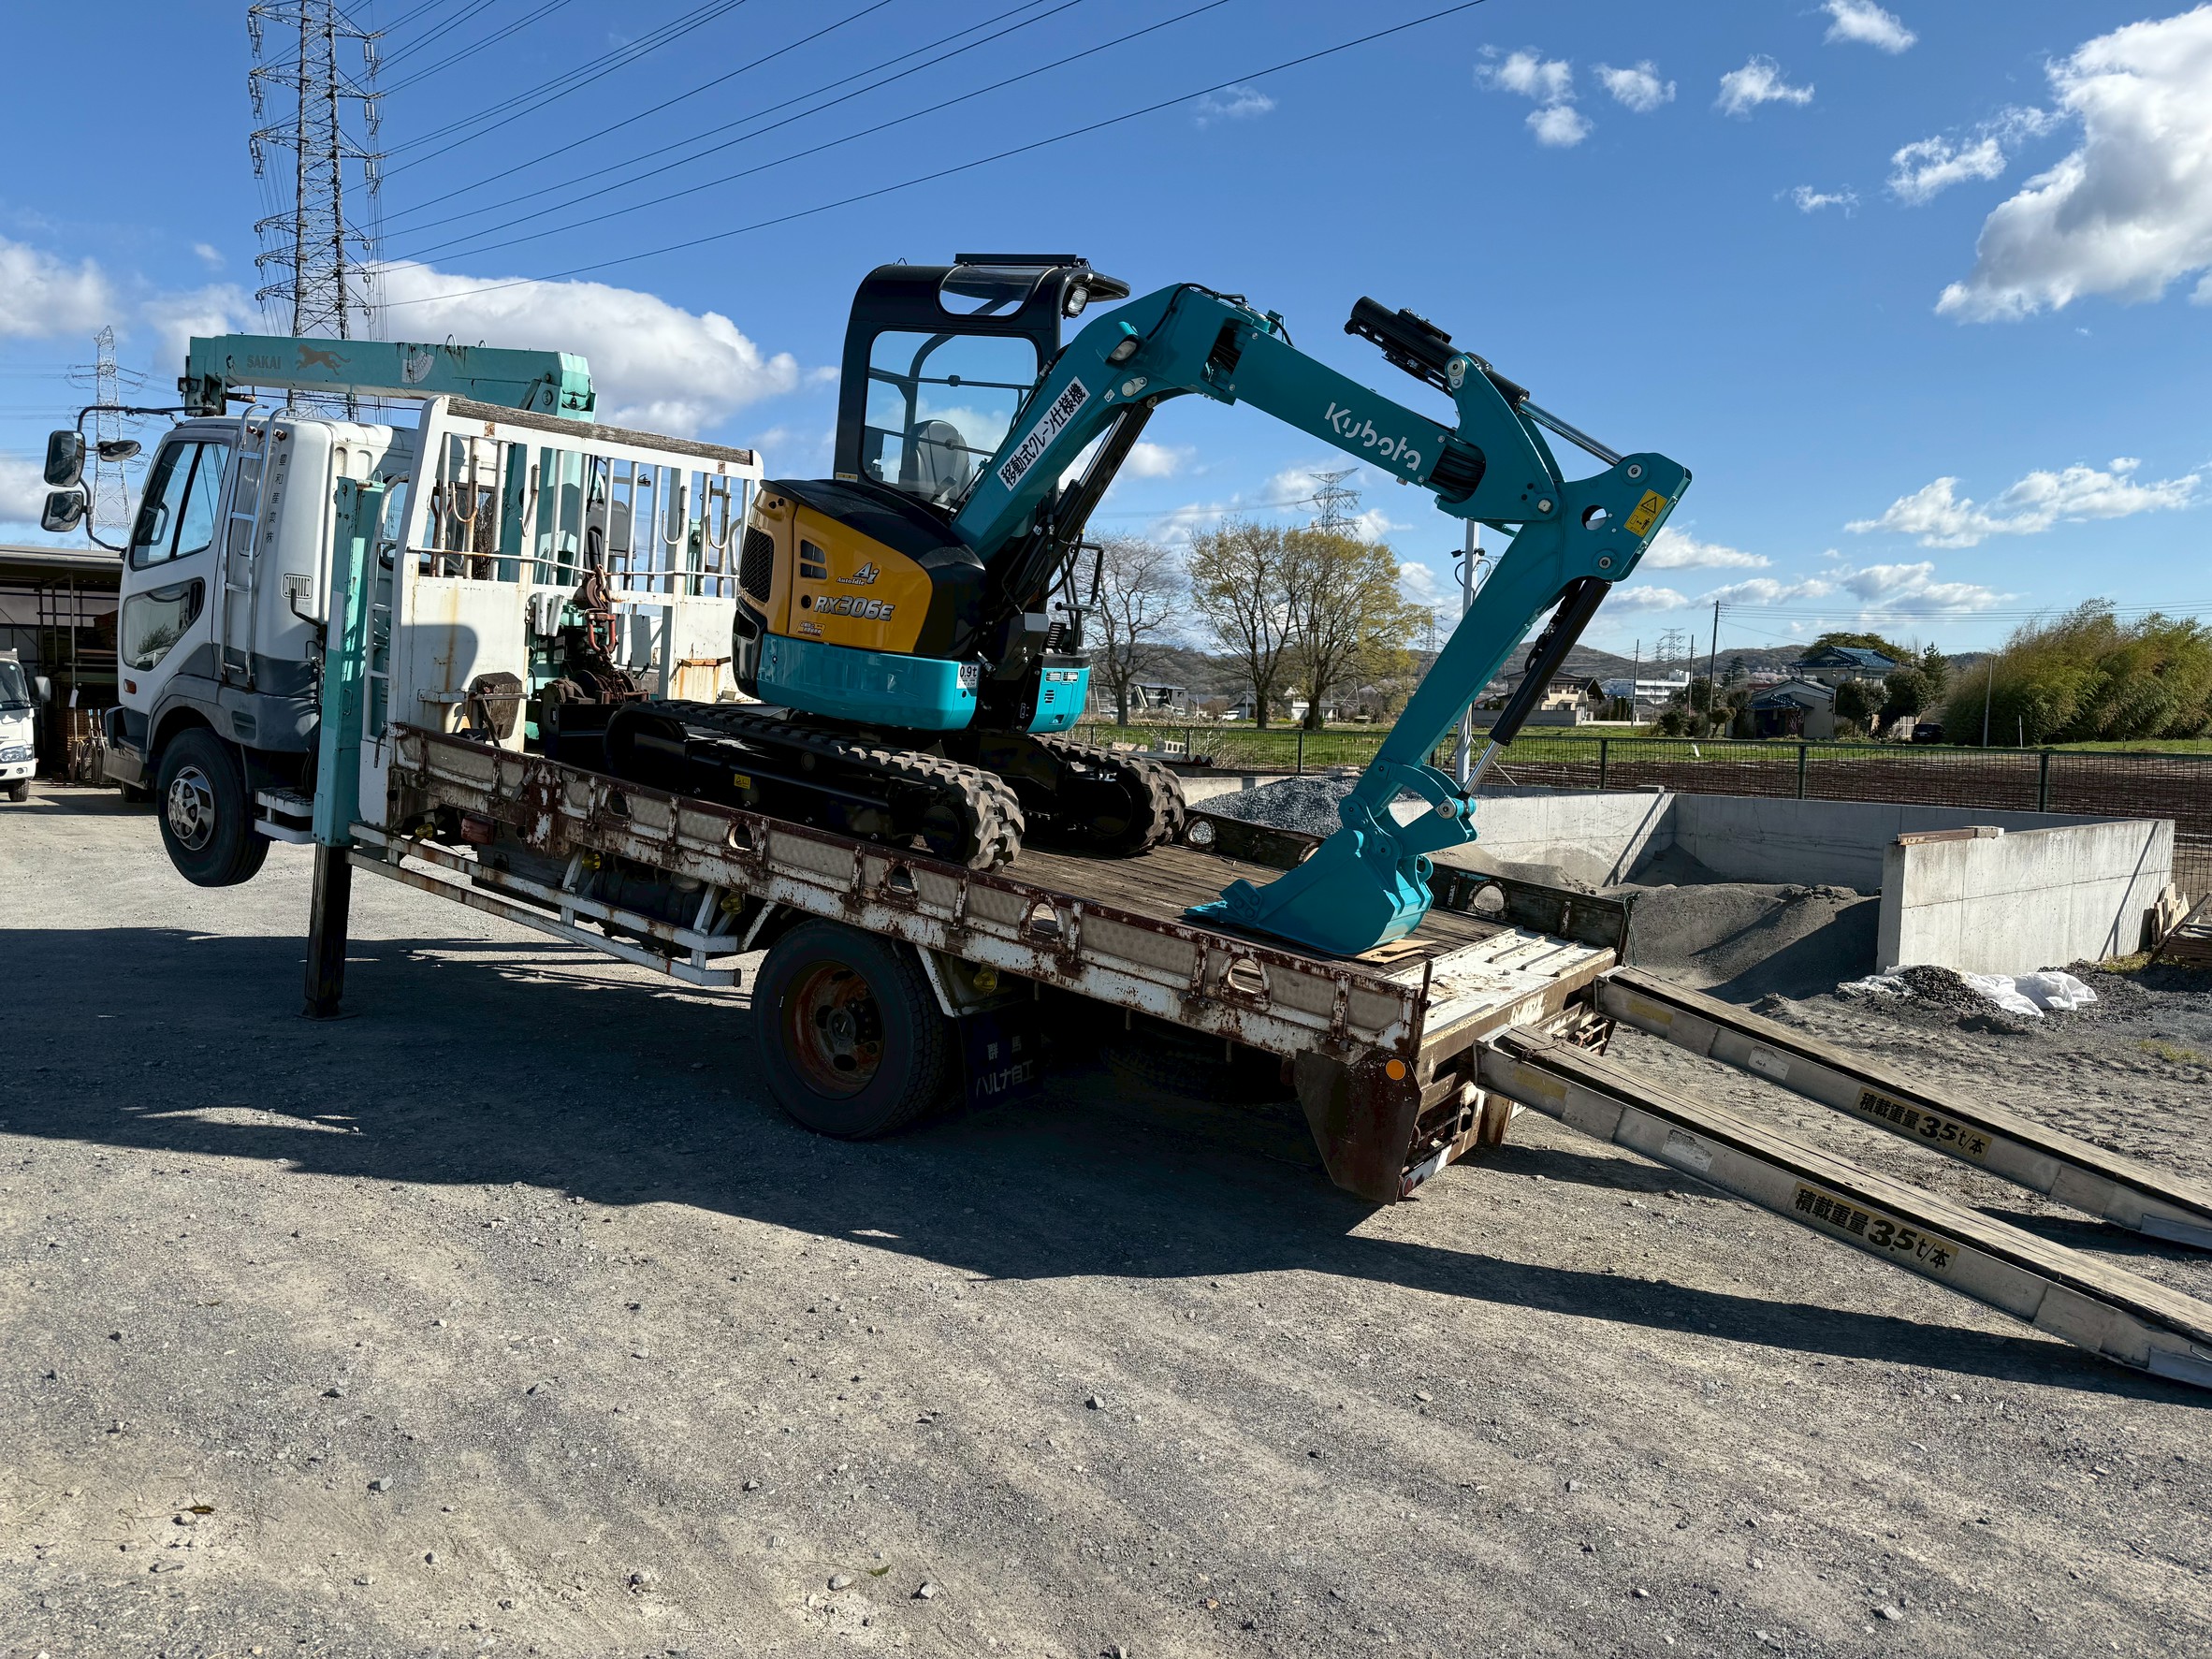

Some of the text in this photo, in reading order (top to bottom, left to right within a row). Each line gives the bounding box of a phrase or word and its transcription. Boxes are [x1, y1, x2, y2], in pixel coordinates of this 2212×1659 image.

[246, 355, 282, 370] SAKAI
[1000, 382, 1086, 487] 移動式クレーン仕様機
[1324, 401, 1421, 472] Kubota
[813, 595, 895, 621] RX306E
[976, 1059, 1034, 1099] ハルナ自工
